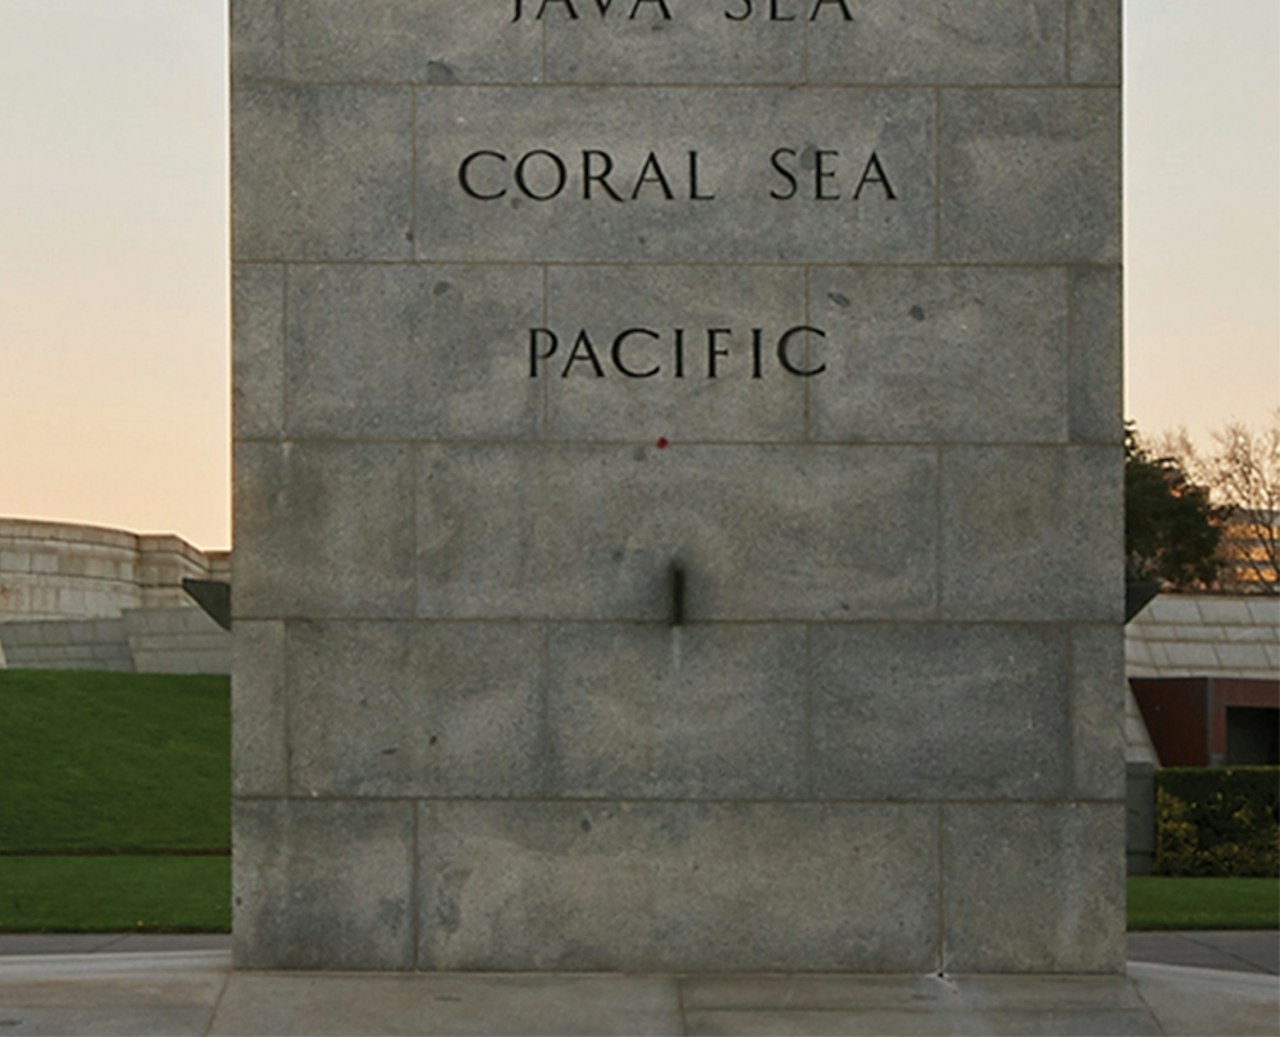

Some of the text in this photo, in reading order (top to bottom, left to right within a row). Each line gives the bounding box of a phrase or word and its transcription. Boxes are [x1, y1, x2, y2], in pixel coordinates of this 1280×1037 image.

[459, 149, 898, 202] CORAL SEA
[528, 327, 828, 378] PACIFIC
